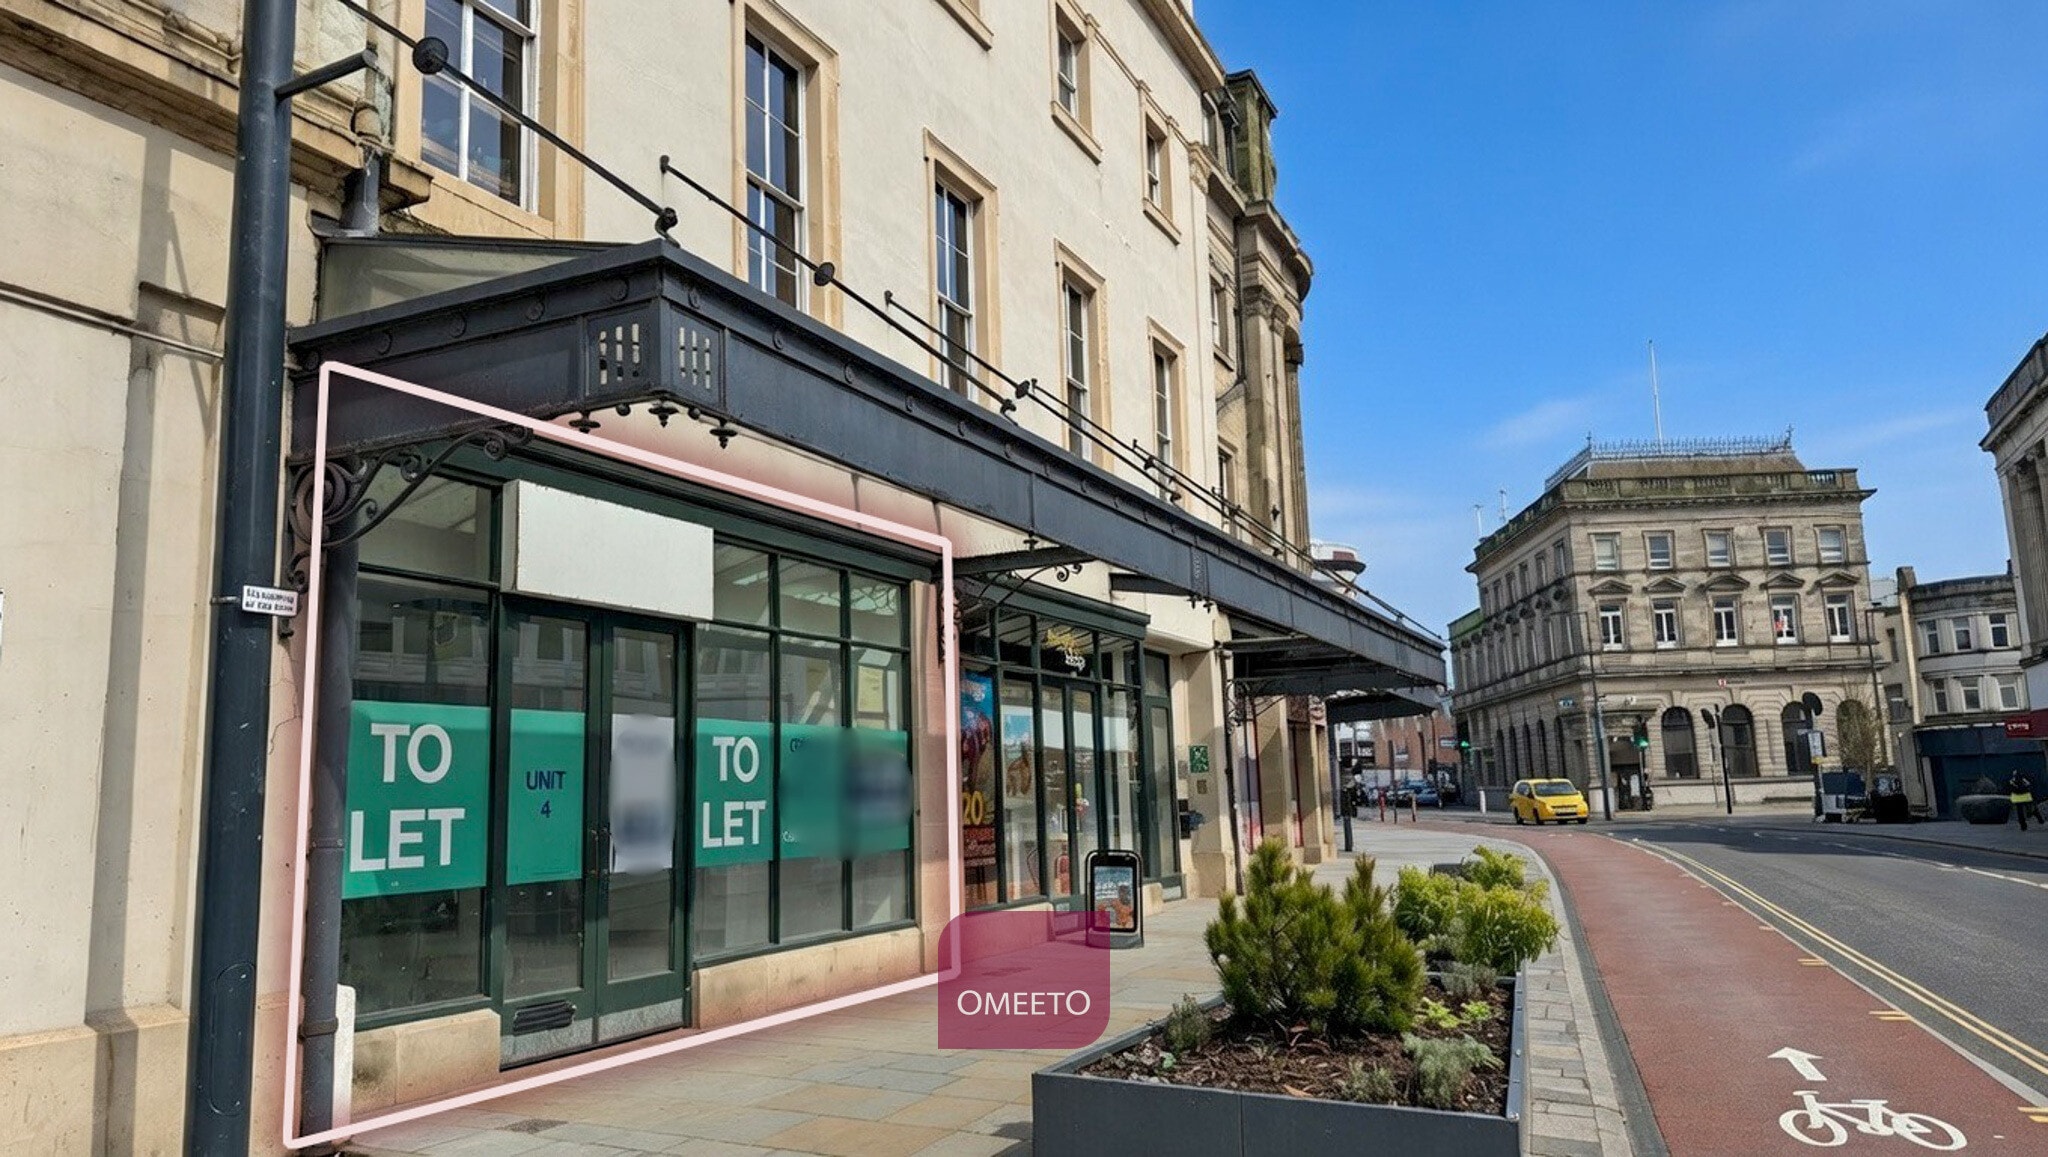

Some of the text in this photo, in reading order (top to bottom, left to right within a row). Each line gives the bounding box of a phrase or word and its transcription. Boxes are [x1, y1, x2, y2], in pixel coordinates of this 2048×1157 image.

[371, 723, 452, 784] TO
[713, 736, 760, 783] TO
[526, 770, 567, 790] UNIT
[540, 800, 552, 819] 4
[702, 800, 767, 848] LET
[350, 807, 466, 873] LET
